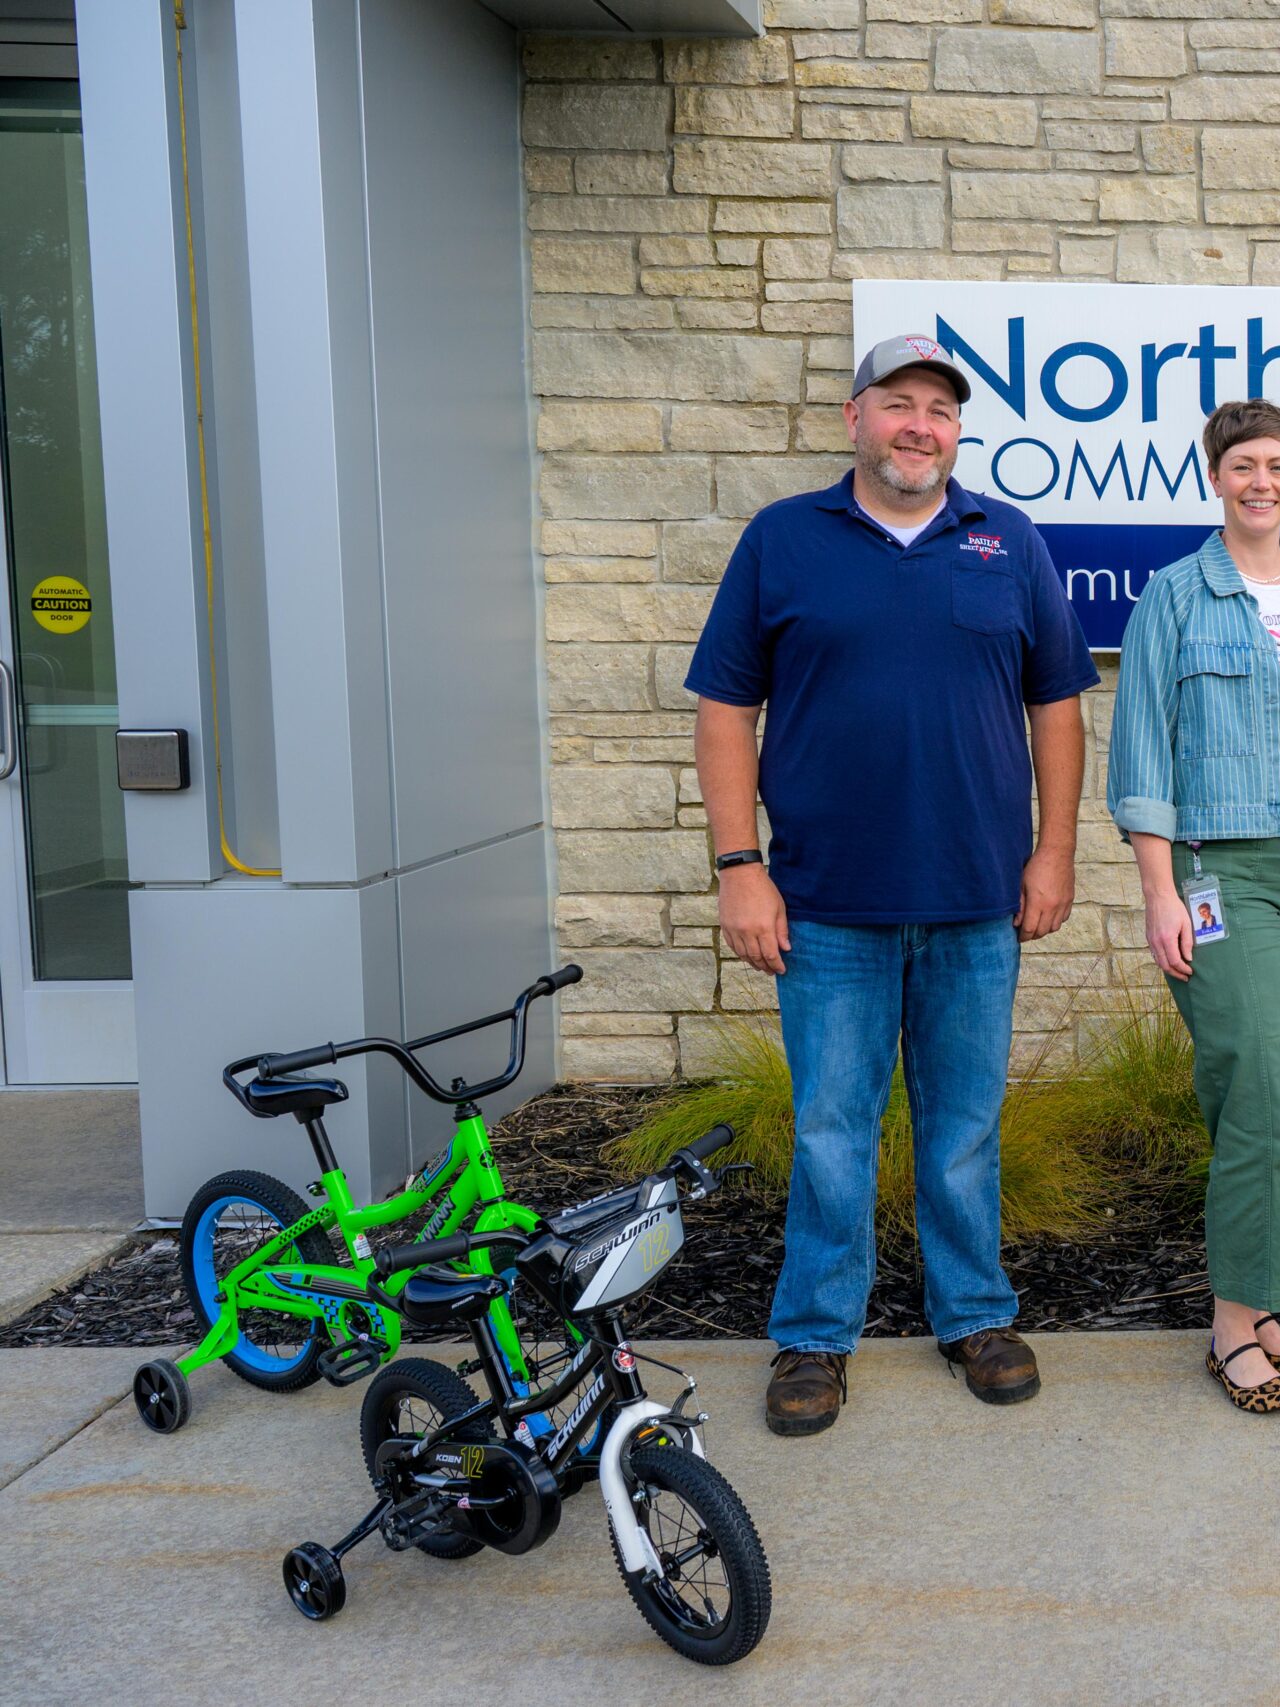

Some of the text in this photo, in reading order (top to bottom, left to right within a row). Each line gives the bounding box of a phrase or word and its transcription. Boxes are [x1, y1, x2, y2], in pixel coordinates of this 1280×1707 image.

[968, 537, 1000, 548] PAUL'S
[34, 600, 89, 610] CAUTION
[420, 1194, 456, 1243] WINN
[574, 1211, 661, 1273] SCHWINN
[640, 1223, 670, 1273] 12
[547, 1373, 606, 1462] SCHWINN
[435, 1446, 485, 1479] KOEN 12
